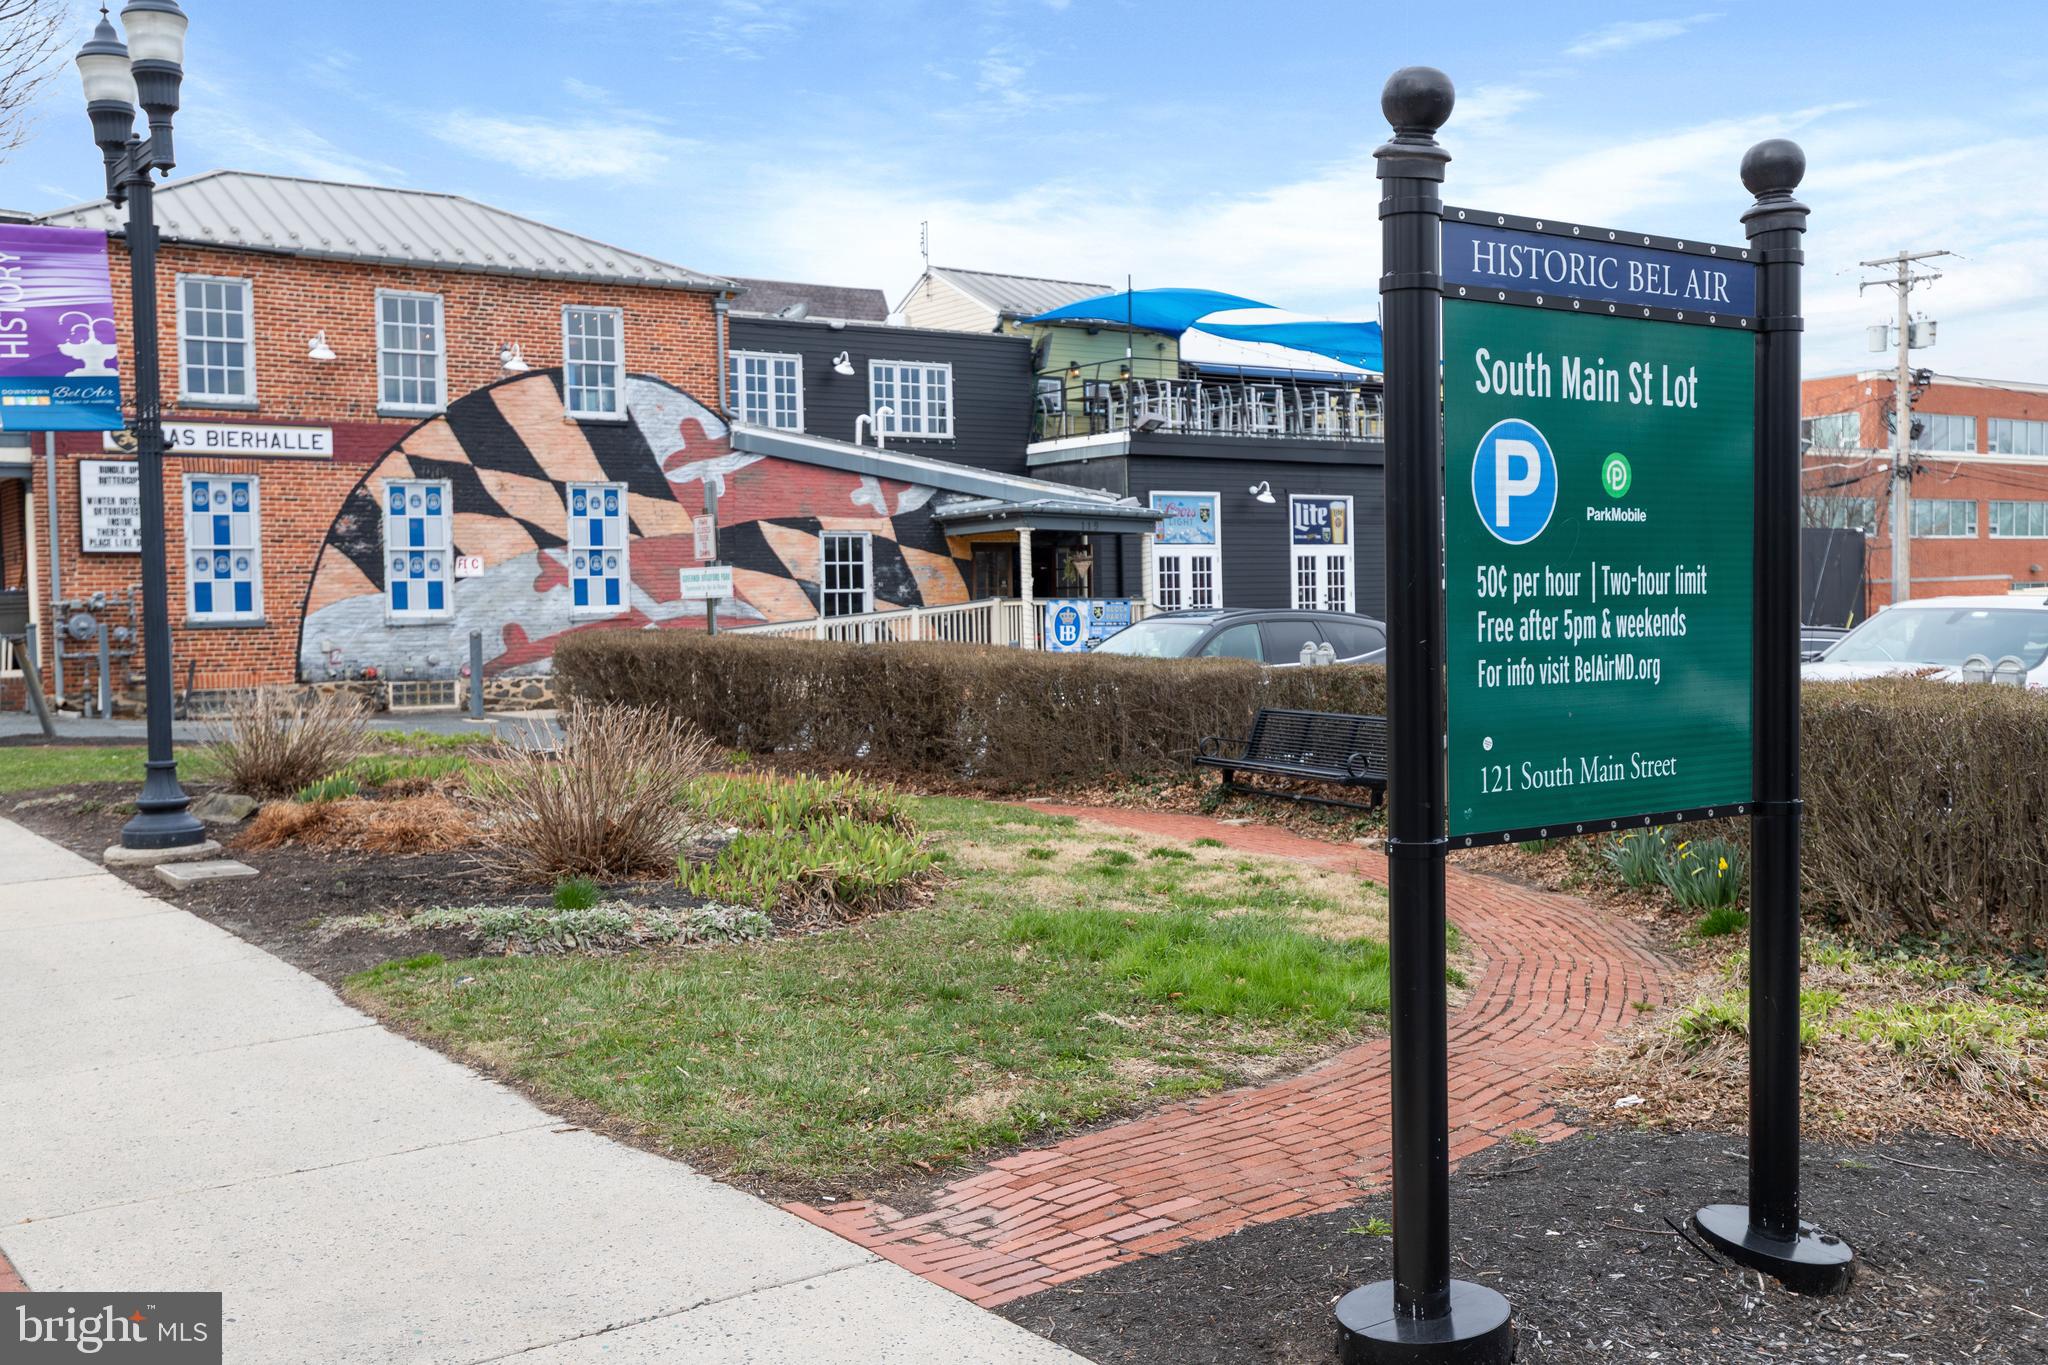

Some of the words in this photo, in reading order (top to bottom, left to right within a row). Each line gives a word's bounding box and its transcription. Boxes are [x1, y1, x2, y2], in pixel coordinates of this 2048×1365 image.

[1472, 240, 1618, 290] HISTORIC
[1628, 261, 1677, 296] BEL
[1684, 268, 1730, 303] AIR
[1476, 348, 1551, 398] South
[1562, 355, 1619, 402] Main
[1629, 361, 1652, 406] St
[1663, 365, 1698, 408] Lot
[52, 386, 79, 397] Bel
[82, 385, 115, 398] Air
[162, 429, 195, 446] AS
[206, 430, 324, 450] BIERHALLE
[99, 466, 125, 474] BUNDLE
[1495, 438, 1541, 527] P
[87, 497, 115, 505] WINTER
[1166, 502, 1196, 518] Coors
[107, 518, 132, 526] INSIDE
[1294, 503, 1328, 531] Lite
[1586, 507, 1647, 523] ParkMobile
[89, 538, 111, 547] PLACE
[1477, 565, 1507, 601] 50¢
[1514, 572, 1540, 604] per
[1546, 564, 1580, 597] hour
[1602, 565, 1671, 596] Two-hour
[1676, 564, 1707, 595] limit
[1060, 625, 1076, 641] HB
[1478, 611, 1513, 642] Free
[1520, 608, 1558, 641] after
[1564, 609, 1596, 647] 5pm
[1601, 608, 1611, 639] &
[1616, 606, 1686, 638] weekends
[1478, 659, 1501, 688] For
[1507, 657, 1534, 686] info
[1539, 655, 1569, 685] visit
[1575, 653, 1660, 685] BelAirMD.org
[1480, 764, 1513, 793] 121
[1521, 757, 1574, 790] South
[1580, 755, 1625, 785] Main
[1631, 752, 1676, 780] Street
